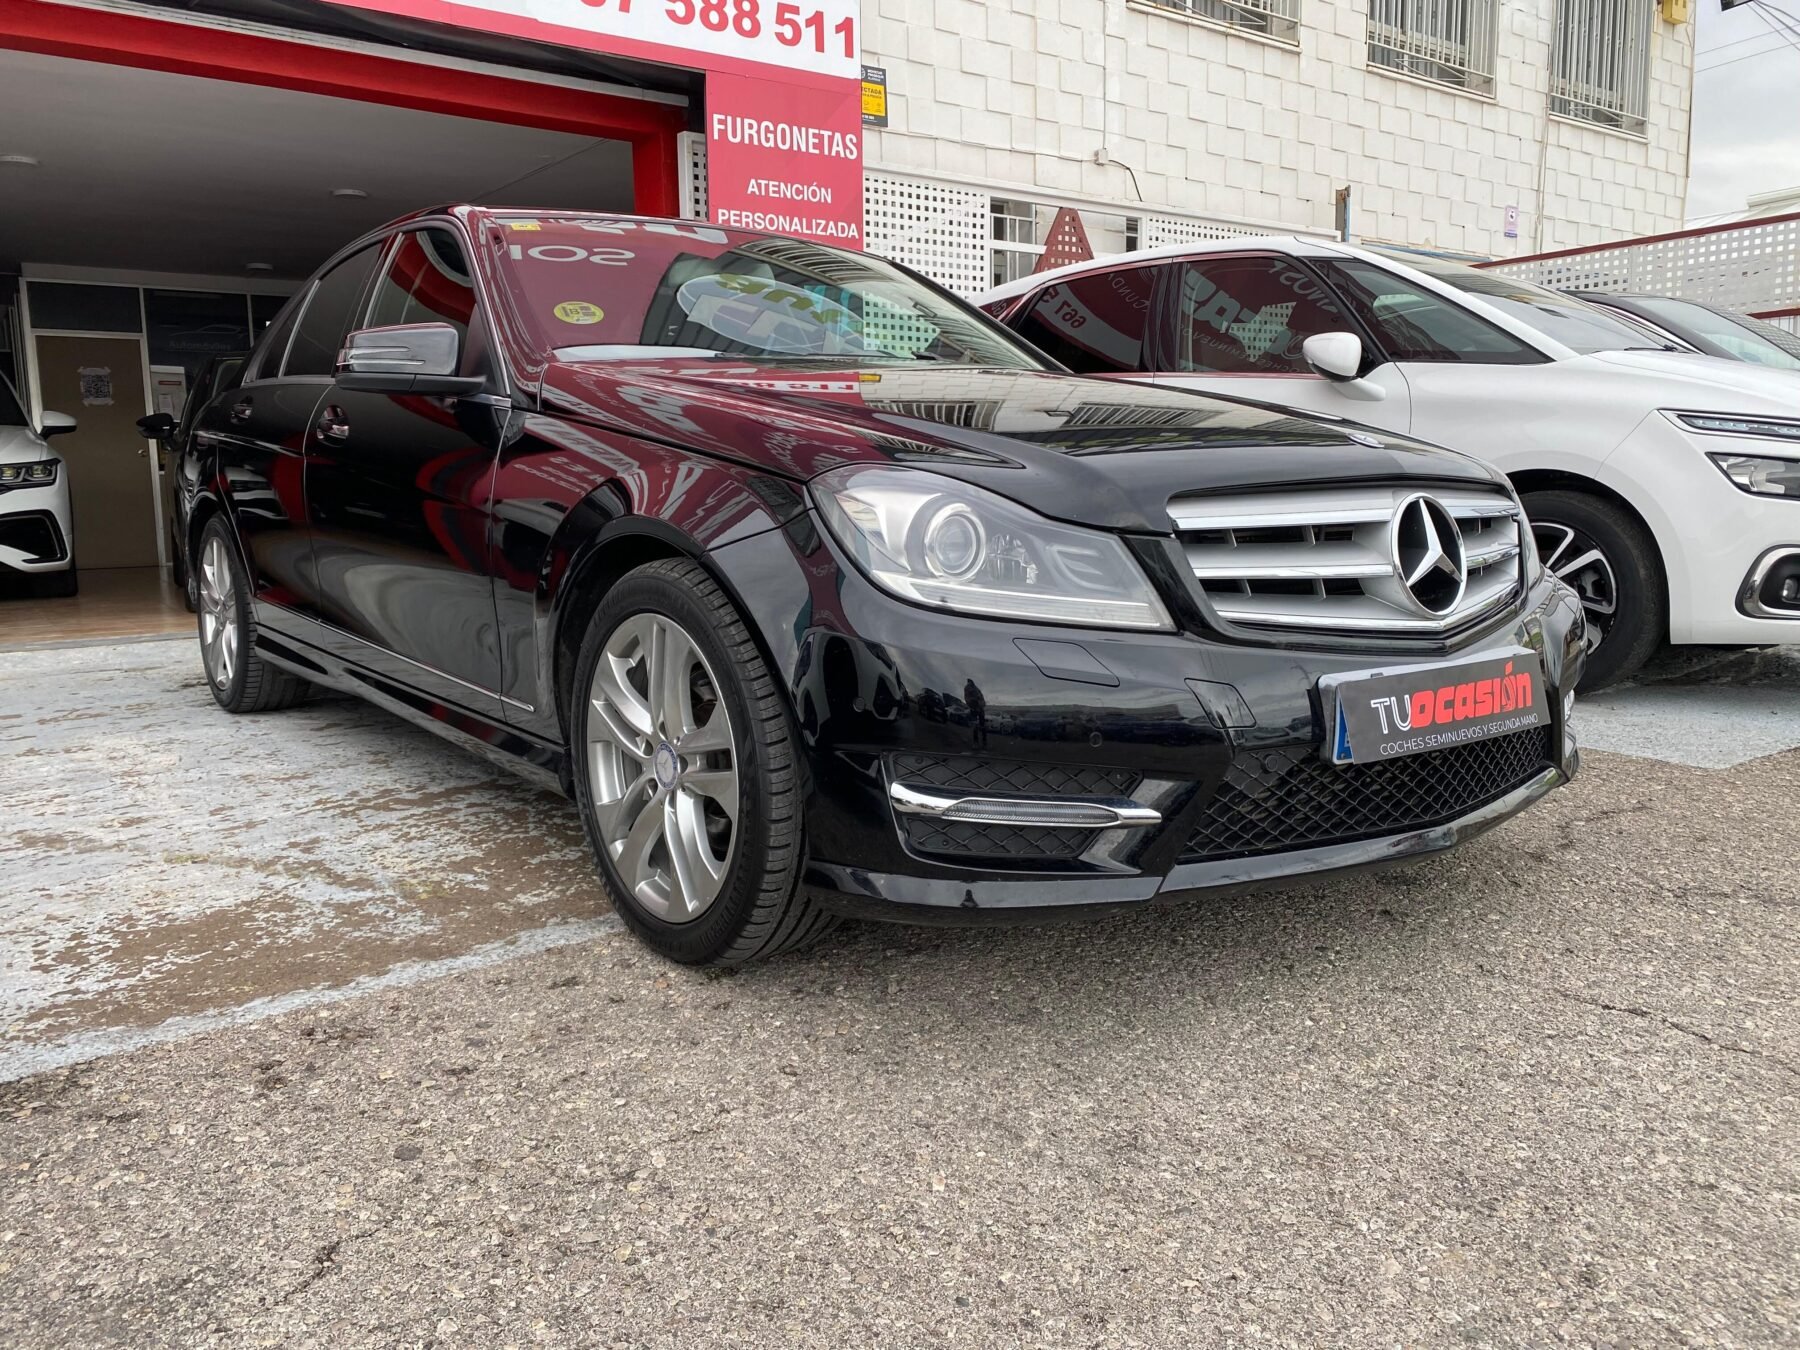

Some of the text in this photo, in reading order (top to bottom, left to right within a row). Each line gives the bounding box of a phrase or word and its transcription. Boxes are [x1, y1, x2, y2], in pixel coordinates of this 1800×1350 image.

[665, 0, 854, 58] 588 511
[713, 113, 858, 160] FURGONETAS
[747, 178, 832, 204] ATENCIÓN
[717, 208, 859, 239] PERSONALIZADA
[1380, 713, 1538, 755] COCHES SEMINUEVOS Y SEGUNDA MANO
